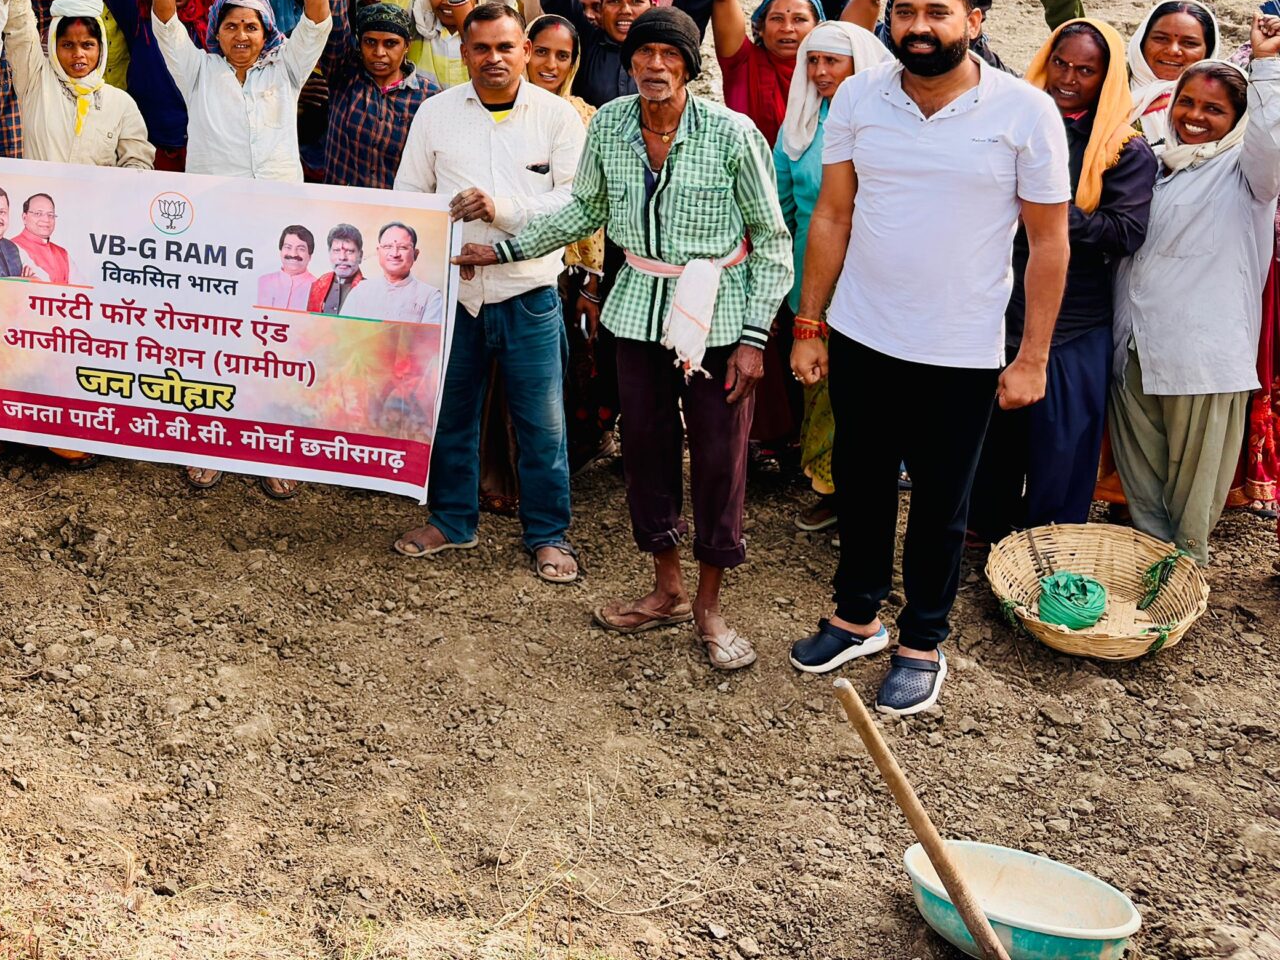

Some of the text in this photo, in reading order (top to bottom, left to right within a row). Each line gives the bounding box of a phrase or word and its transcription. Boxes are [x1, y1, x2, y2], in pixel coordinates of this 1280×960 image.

[89, 233, 254, 270] VB-G RAM G
[102, 261, 238, 296] विकसित भारत
[29, 292, 290, 346] गारंटी फॉर रोजगार एंड
[3, 326, 316, 387] आजीविका मिशन (ग्रामीण)
[76, 366, 236, 411] जन जोहार
[3, 400, 63, 423] जनता
[69, 407, 121, 435] पार्टी,
[128, 412, 233, 447] ओ.बी.सी.
[240, 426, 295, 454] मोर्चा
[299, 435, 406, 474] छत्तीसगढ़
